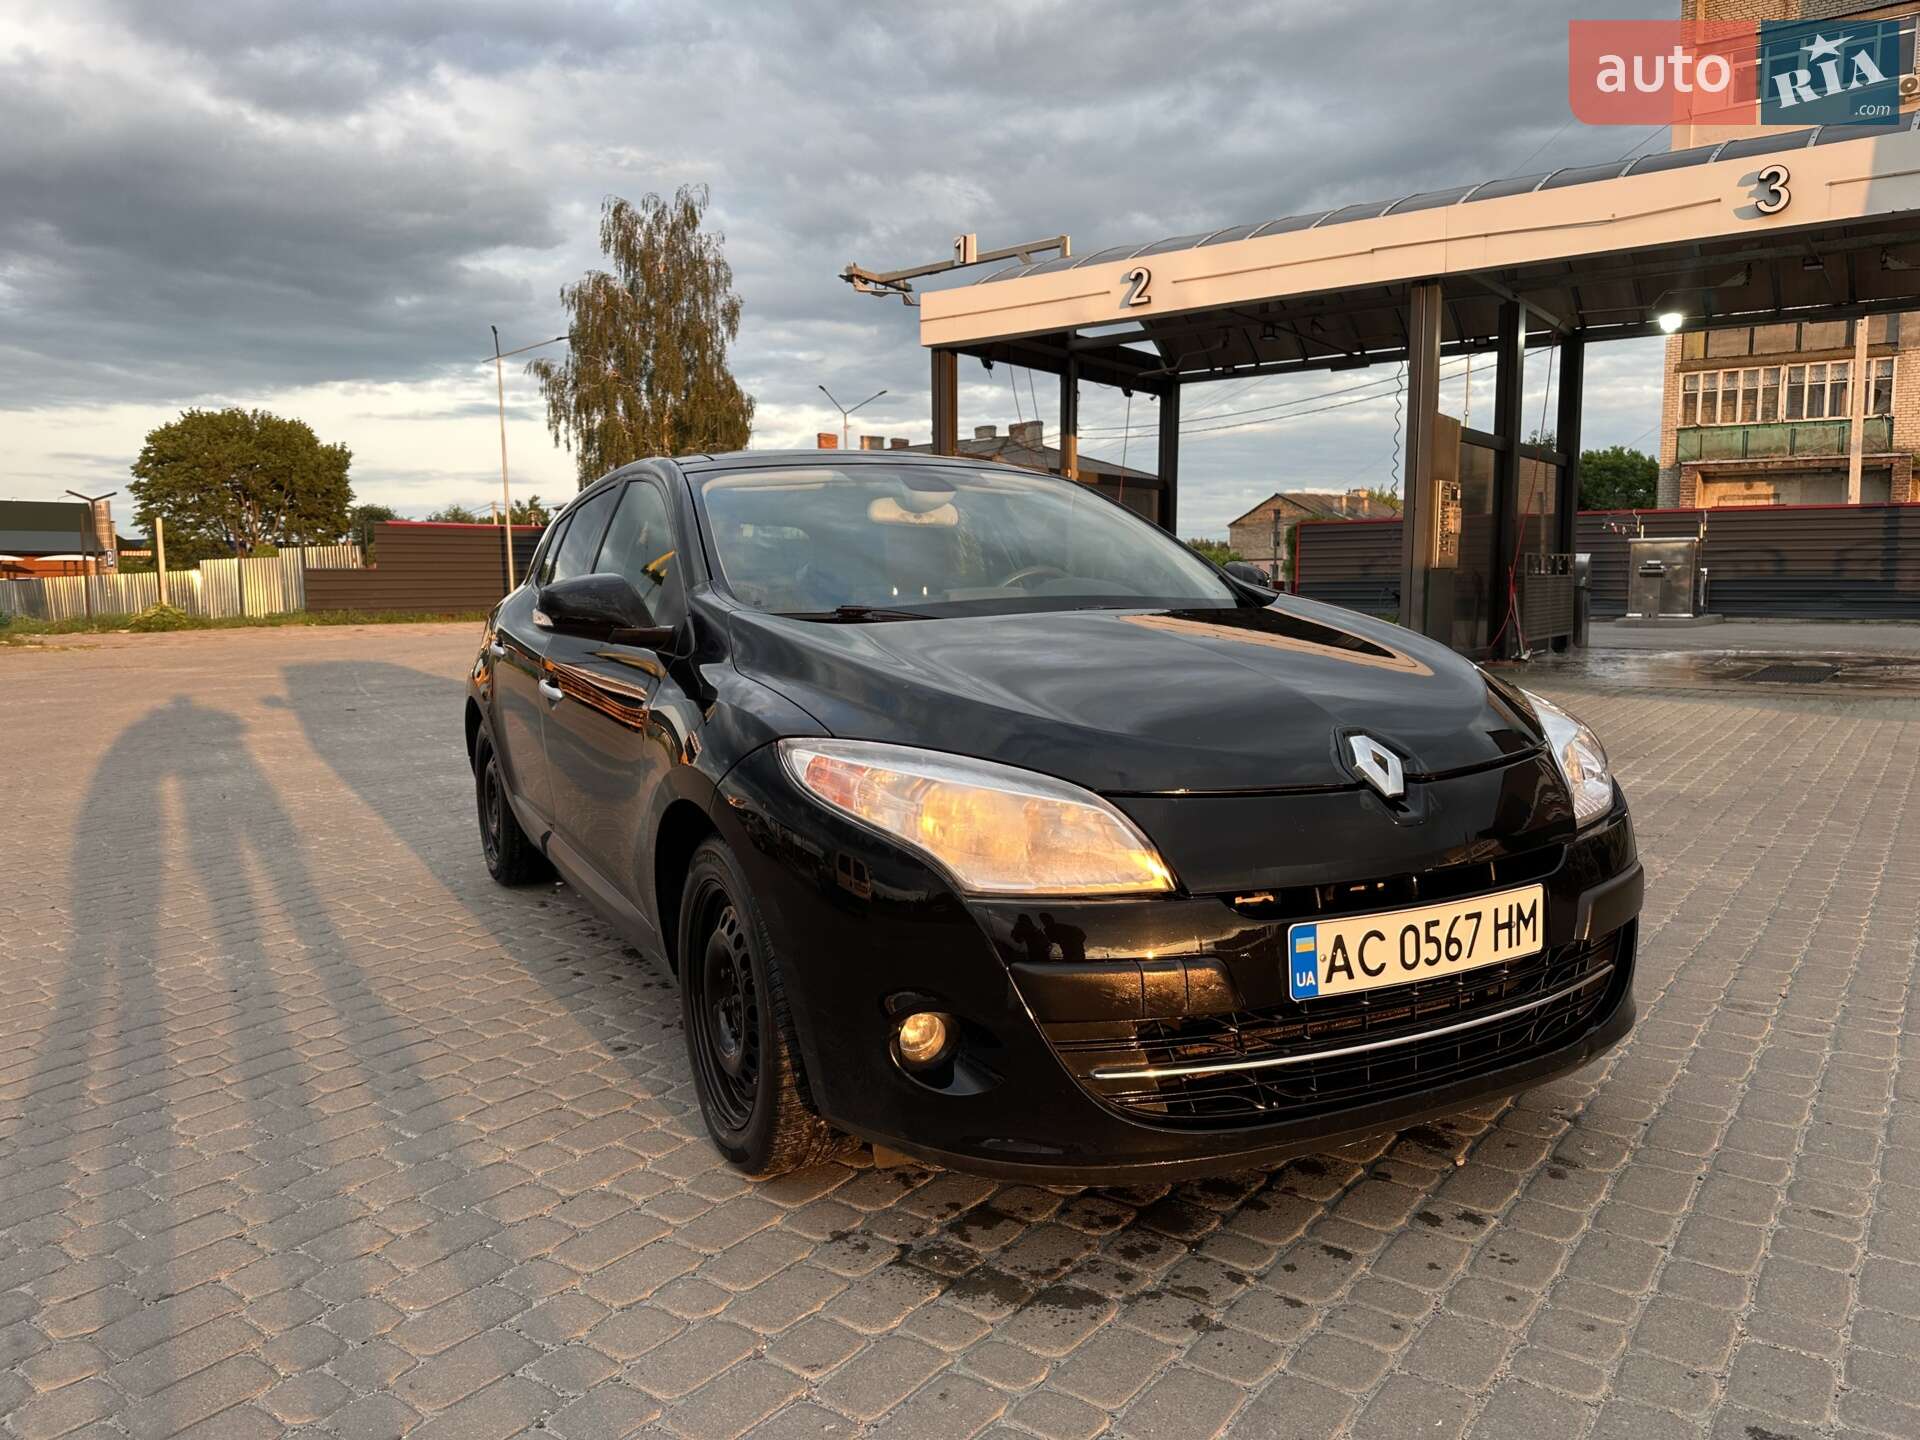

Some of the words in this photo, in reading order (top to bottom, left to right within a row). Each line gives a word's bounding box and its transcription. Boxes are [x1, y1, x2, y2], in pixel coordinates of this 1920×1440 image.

[1755, 164, 1791, 214] 3
[1128, 267, 1151, 307] 2
[1325, 930, 1386, 983] AC
[1400, 911, 1482, 970] 0567
[1493, 898, 1537, 951] HM
[1296, 970, 1316, 987] UA
